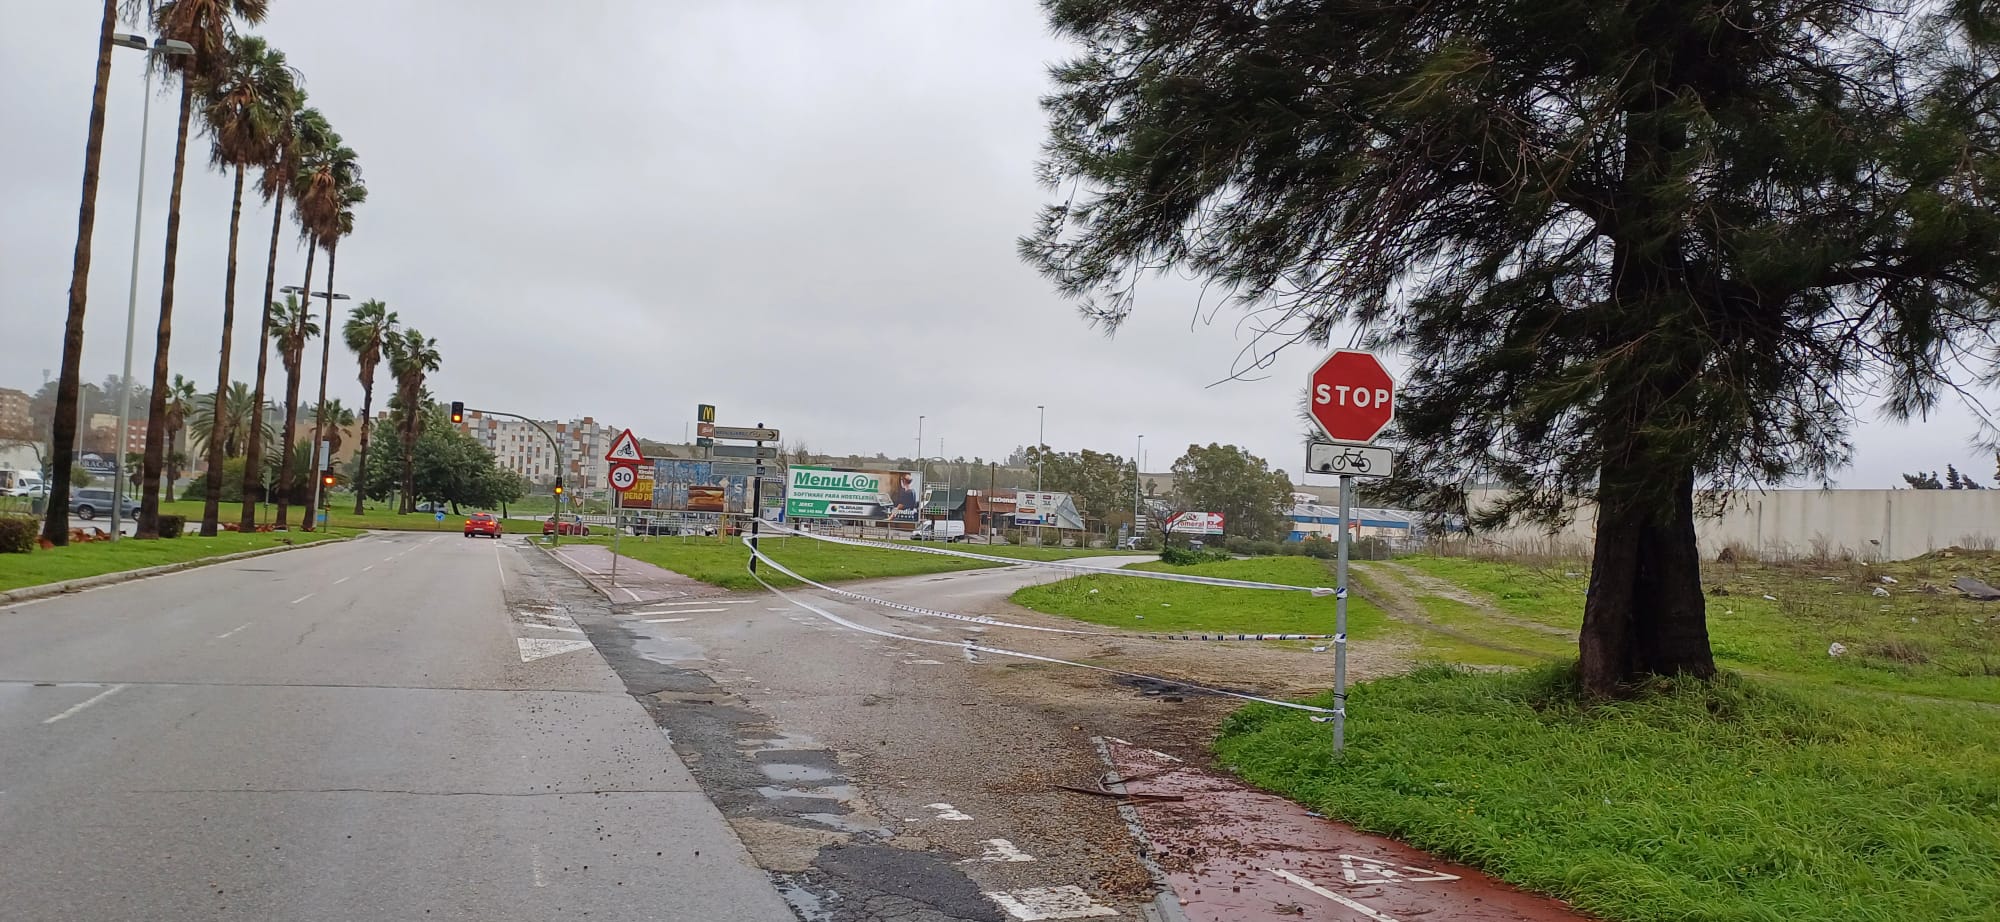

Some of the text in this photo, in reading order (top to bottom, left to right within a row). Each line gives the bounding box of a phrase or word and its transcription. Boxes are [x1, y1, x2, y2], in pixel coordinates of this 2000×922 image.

[1315, 384, 1390, 409] STOP
[614, 472, 632, 483] 30
[794, 471, 879, 492] MenuL@n
[793, 491, 824, 499] SOFTWARE
